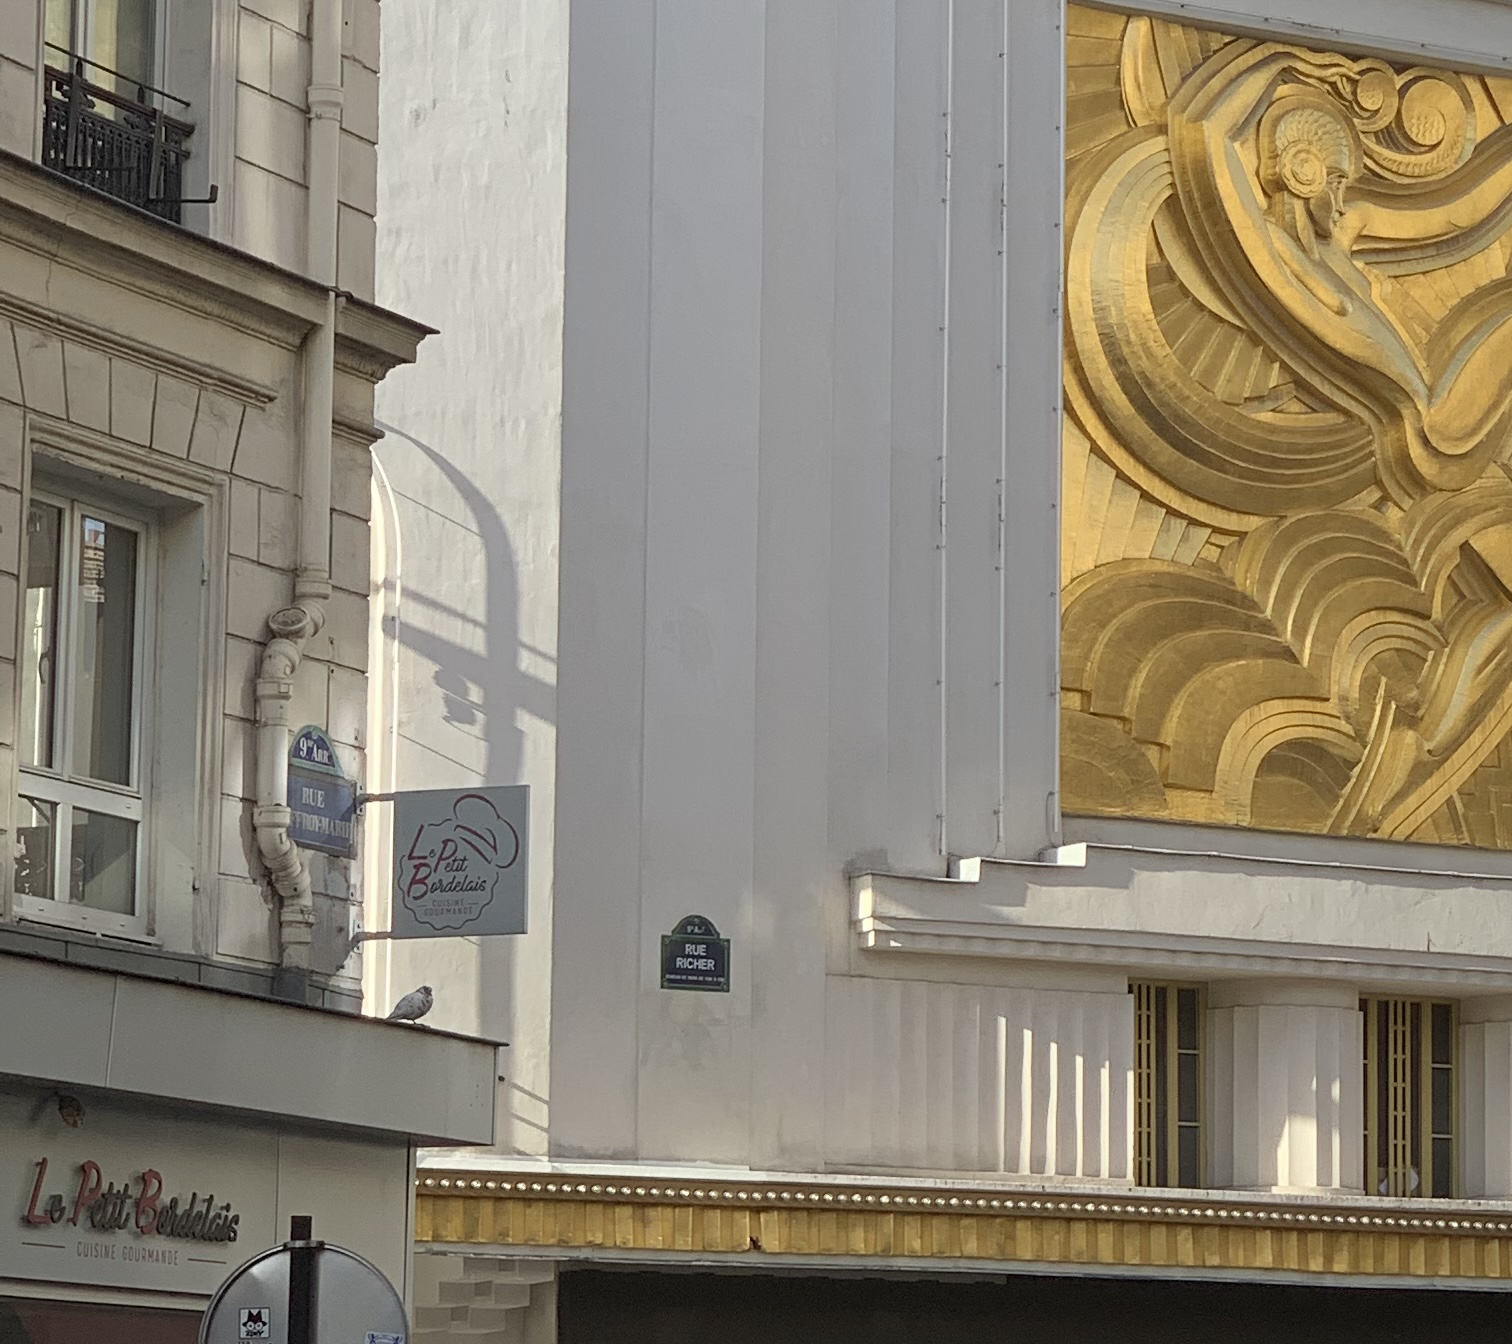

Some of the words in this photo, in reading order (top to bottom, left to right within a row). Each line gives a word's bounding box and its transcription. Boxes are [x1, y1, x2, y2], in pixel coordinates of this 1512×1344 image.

[302, 787, 325, 808] RUE
[408, 824, 437, 861] Le
[434, 838, 469, 873] Petit
[407, 862, 487, 901] Bordelais
[676, 957, 715, 971] RICHER
[685, 943, 707, 956] RUE
[25, 1157, 66, 1225] Le
[67, 1159, 133, 1230] Petit
[135, 1168, 240, 1243] Bordelais
[76, 1241, 116, 1261] CUISINE
[122, 1247, 179, 1266] GOURMANDE
